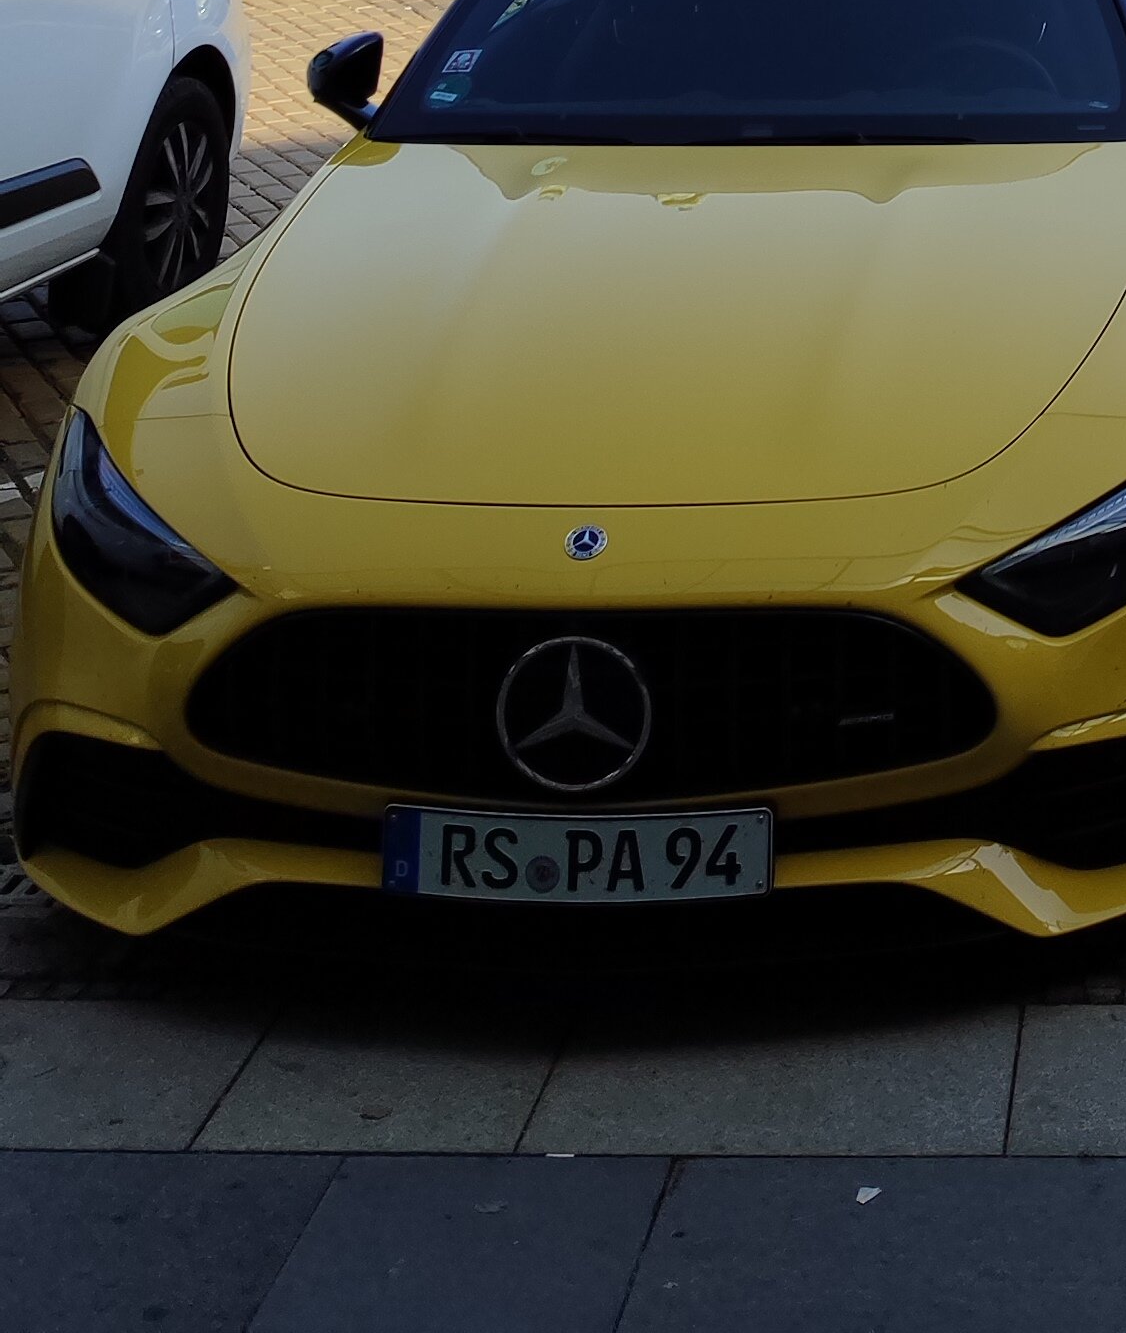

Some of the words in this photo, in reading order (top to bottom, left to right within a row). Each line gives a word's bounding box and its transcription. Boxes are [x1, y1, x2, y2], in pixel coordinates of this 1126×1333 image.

[395, 860, 408, 877] D
[441, 823, 519, 889] RS
[566, 828, 645, 892] PA
[665, 824, 743, 890] 94
